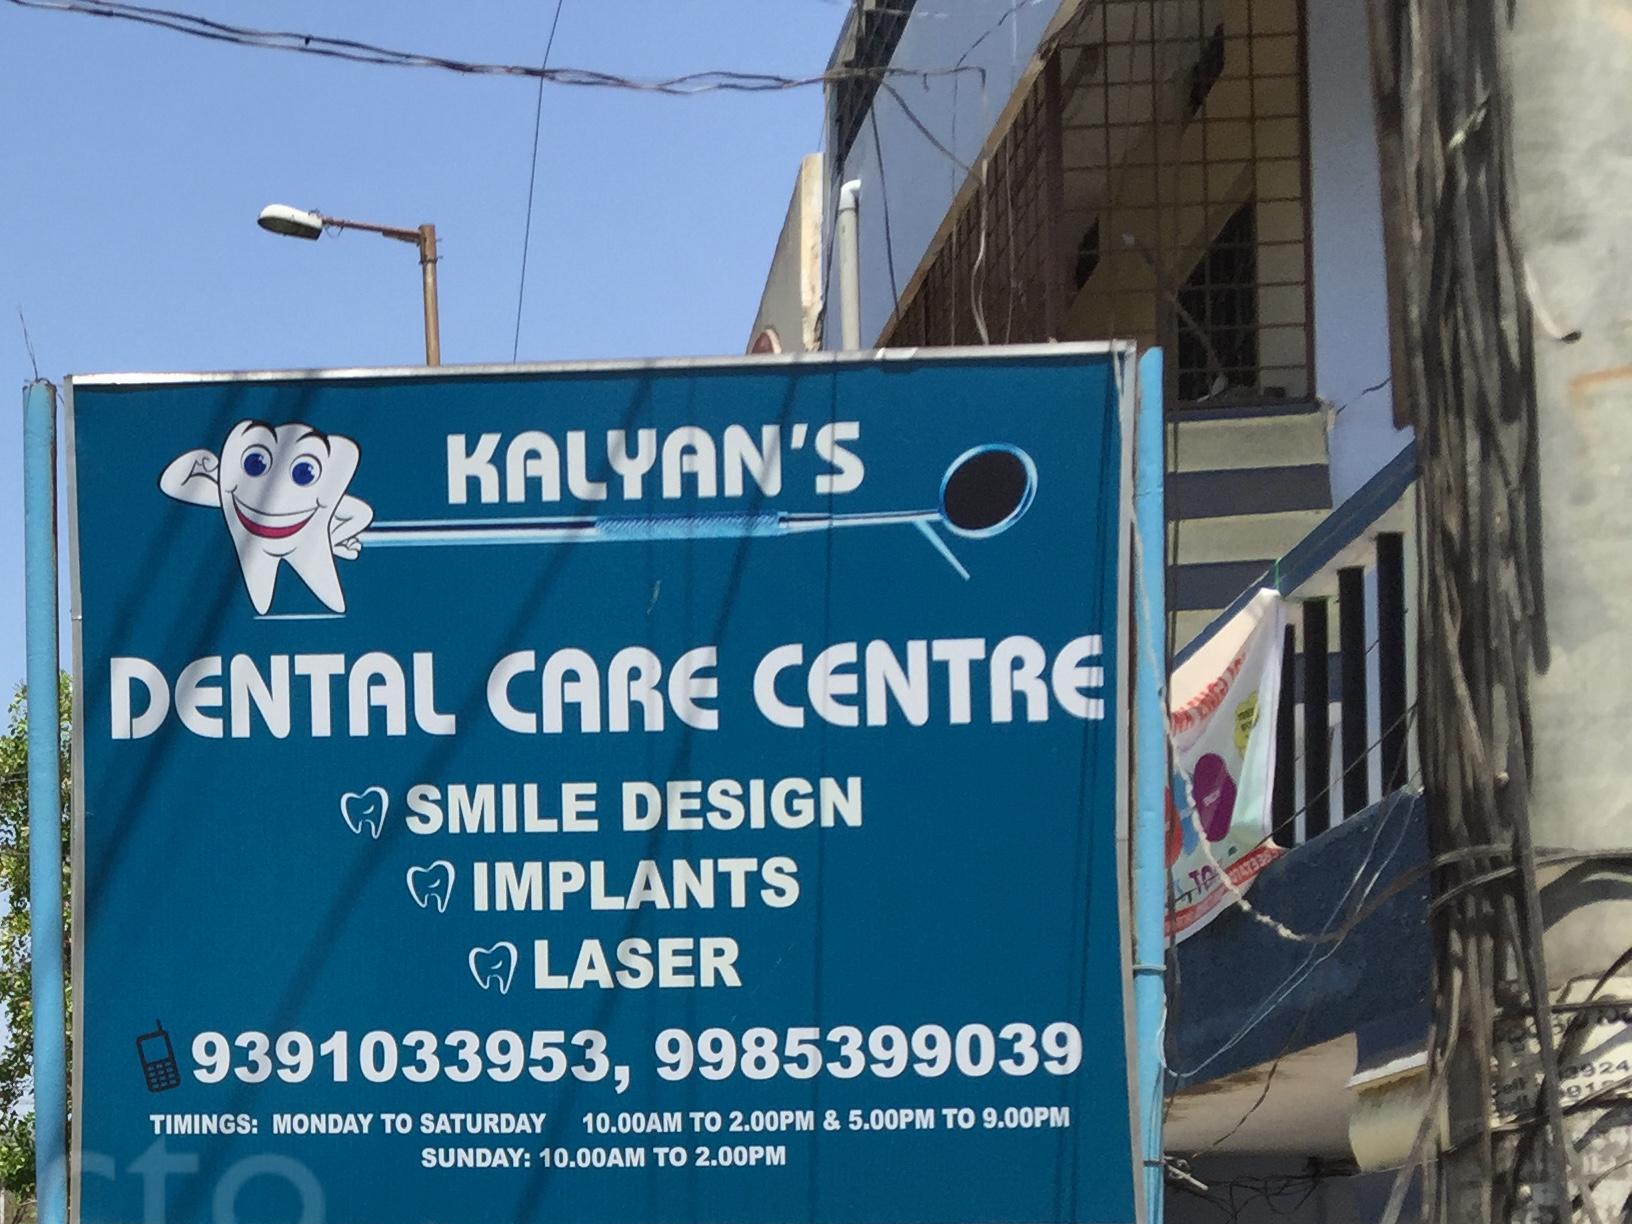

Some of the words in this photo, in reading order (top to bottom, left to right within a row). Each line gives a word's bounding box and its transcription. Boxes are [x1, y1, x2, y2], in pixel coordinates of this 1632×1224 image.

[448, 422, 864, 503] KALYAN'S
[111, 652, 455, 739] DENTAL
[487, 647, 718, 733] CARE
[754, 635, 1104, 727] CENTRE
[406, 783, 598, 834] SMILE
[623, 777, 861, 830] DESIGN
[474, 857, 799, 911] IMPLANTS
[535, 938, 741, 988] LASER
[192, 1030, 629, 1093] 9391033953,
[656, 1022, 1082, 1080] 9985399039
[150, 1114, 257, 1134] TIMINGS:
[273, 1114, 373, 1133] MONDAY
[381, 1114, 412, 1133] TO
[421, 1114, 546, 1133] SATURDAY
[583, 1112, 681, 1133] 10.00AM
[690, 1112, 721, 1132] TO
[730, 1111, 813, 1131] 2.00PM
[824, 1110, 840, 1130] &
[849, 1109, 934, 1130] 5.00PM
[942, 1108, 975, 1128] TO
[983, 1107, 1069, 1128] 9.00PM
[422, 1148, 530, 1167] SUNDAY:
[540, 1148, 644, 1167] 10.00AM
[653, 1147, 687, 1166] TO
[696, 1146, 785, 1166] 2.00PM
